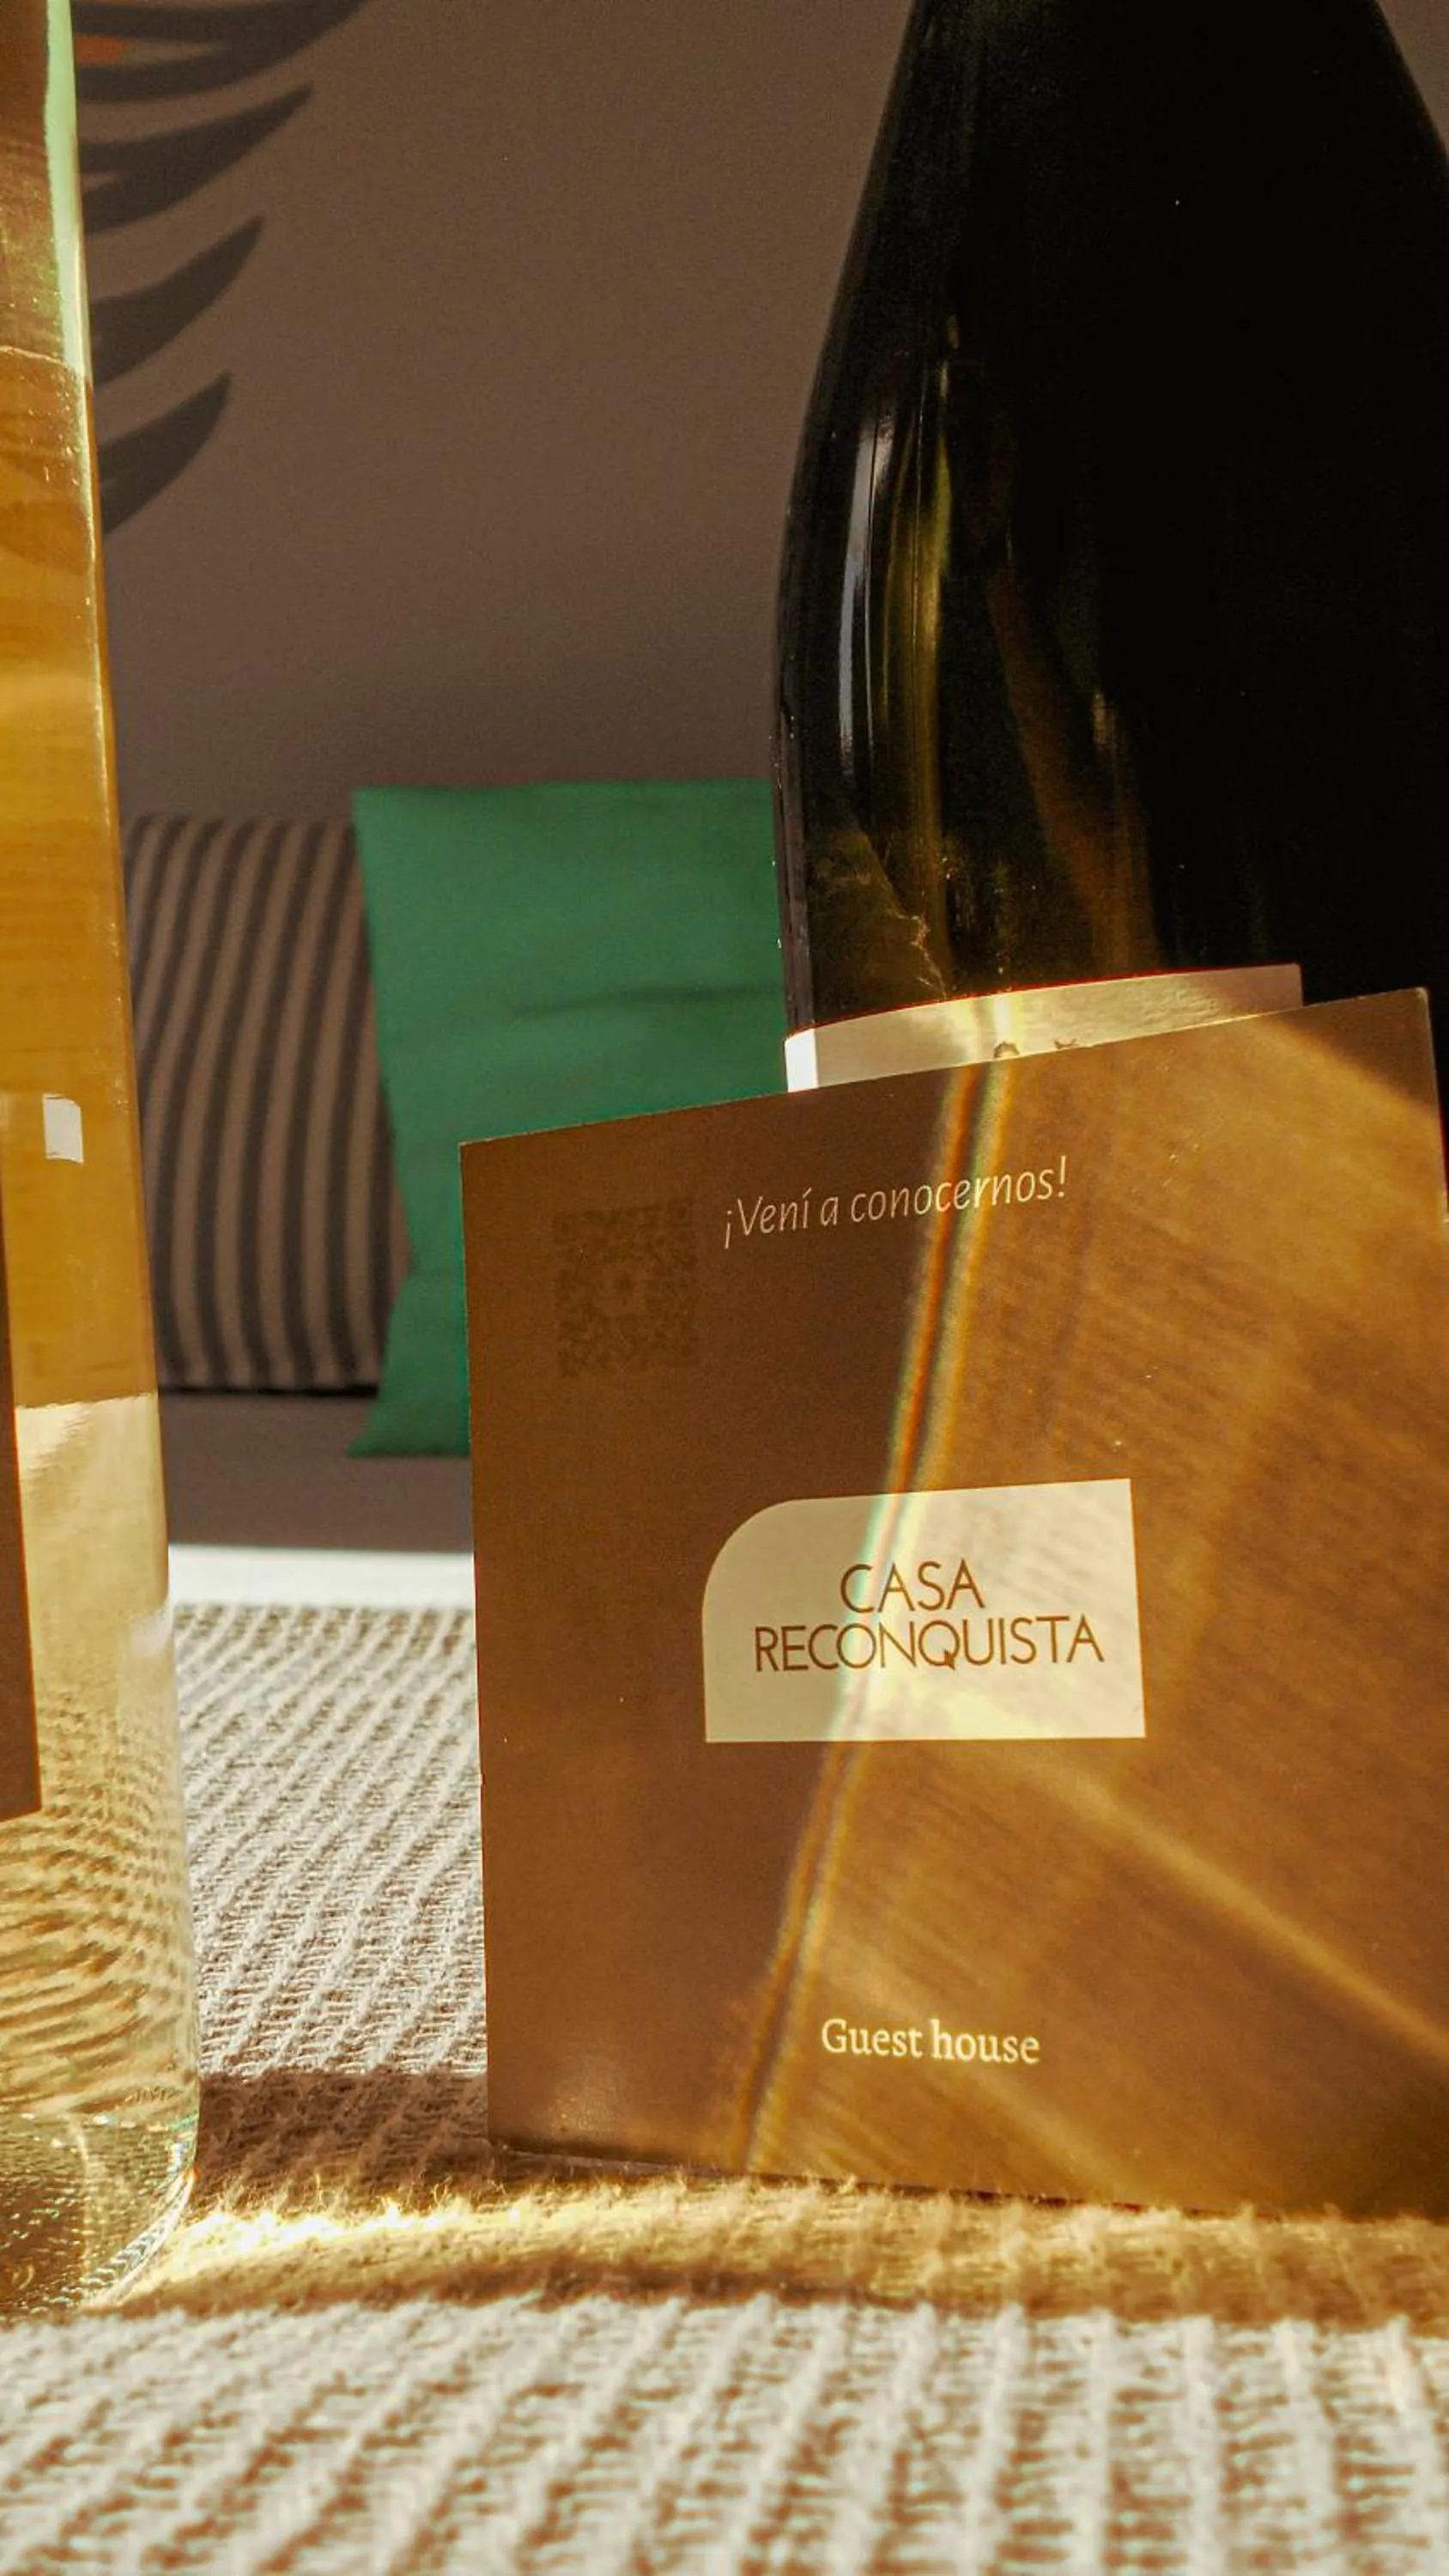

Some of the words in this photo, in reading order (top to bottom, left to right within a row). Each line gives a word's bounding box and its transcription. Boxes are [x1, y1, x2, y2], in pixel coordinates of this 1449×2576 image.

[723, 1188, 812, 1249] ¡Vení
[820, 1194, 839, 1226] a
[850, 1155, 1068, 1220] conocernos!
[840, 1558, 986, 1614] CASA
[755, 1614, 1105, 1672] RECONQUISTA
[821, 2018, 923, 2058] Guest
[929, 2018, 1040, 2064] house
